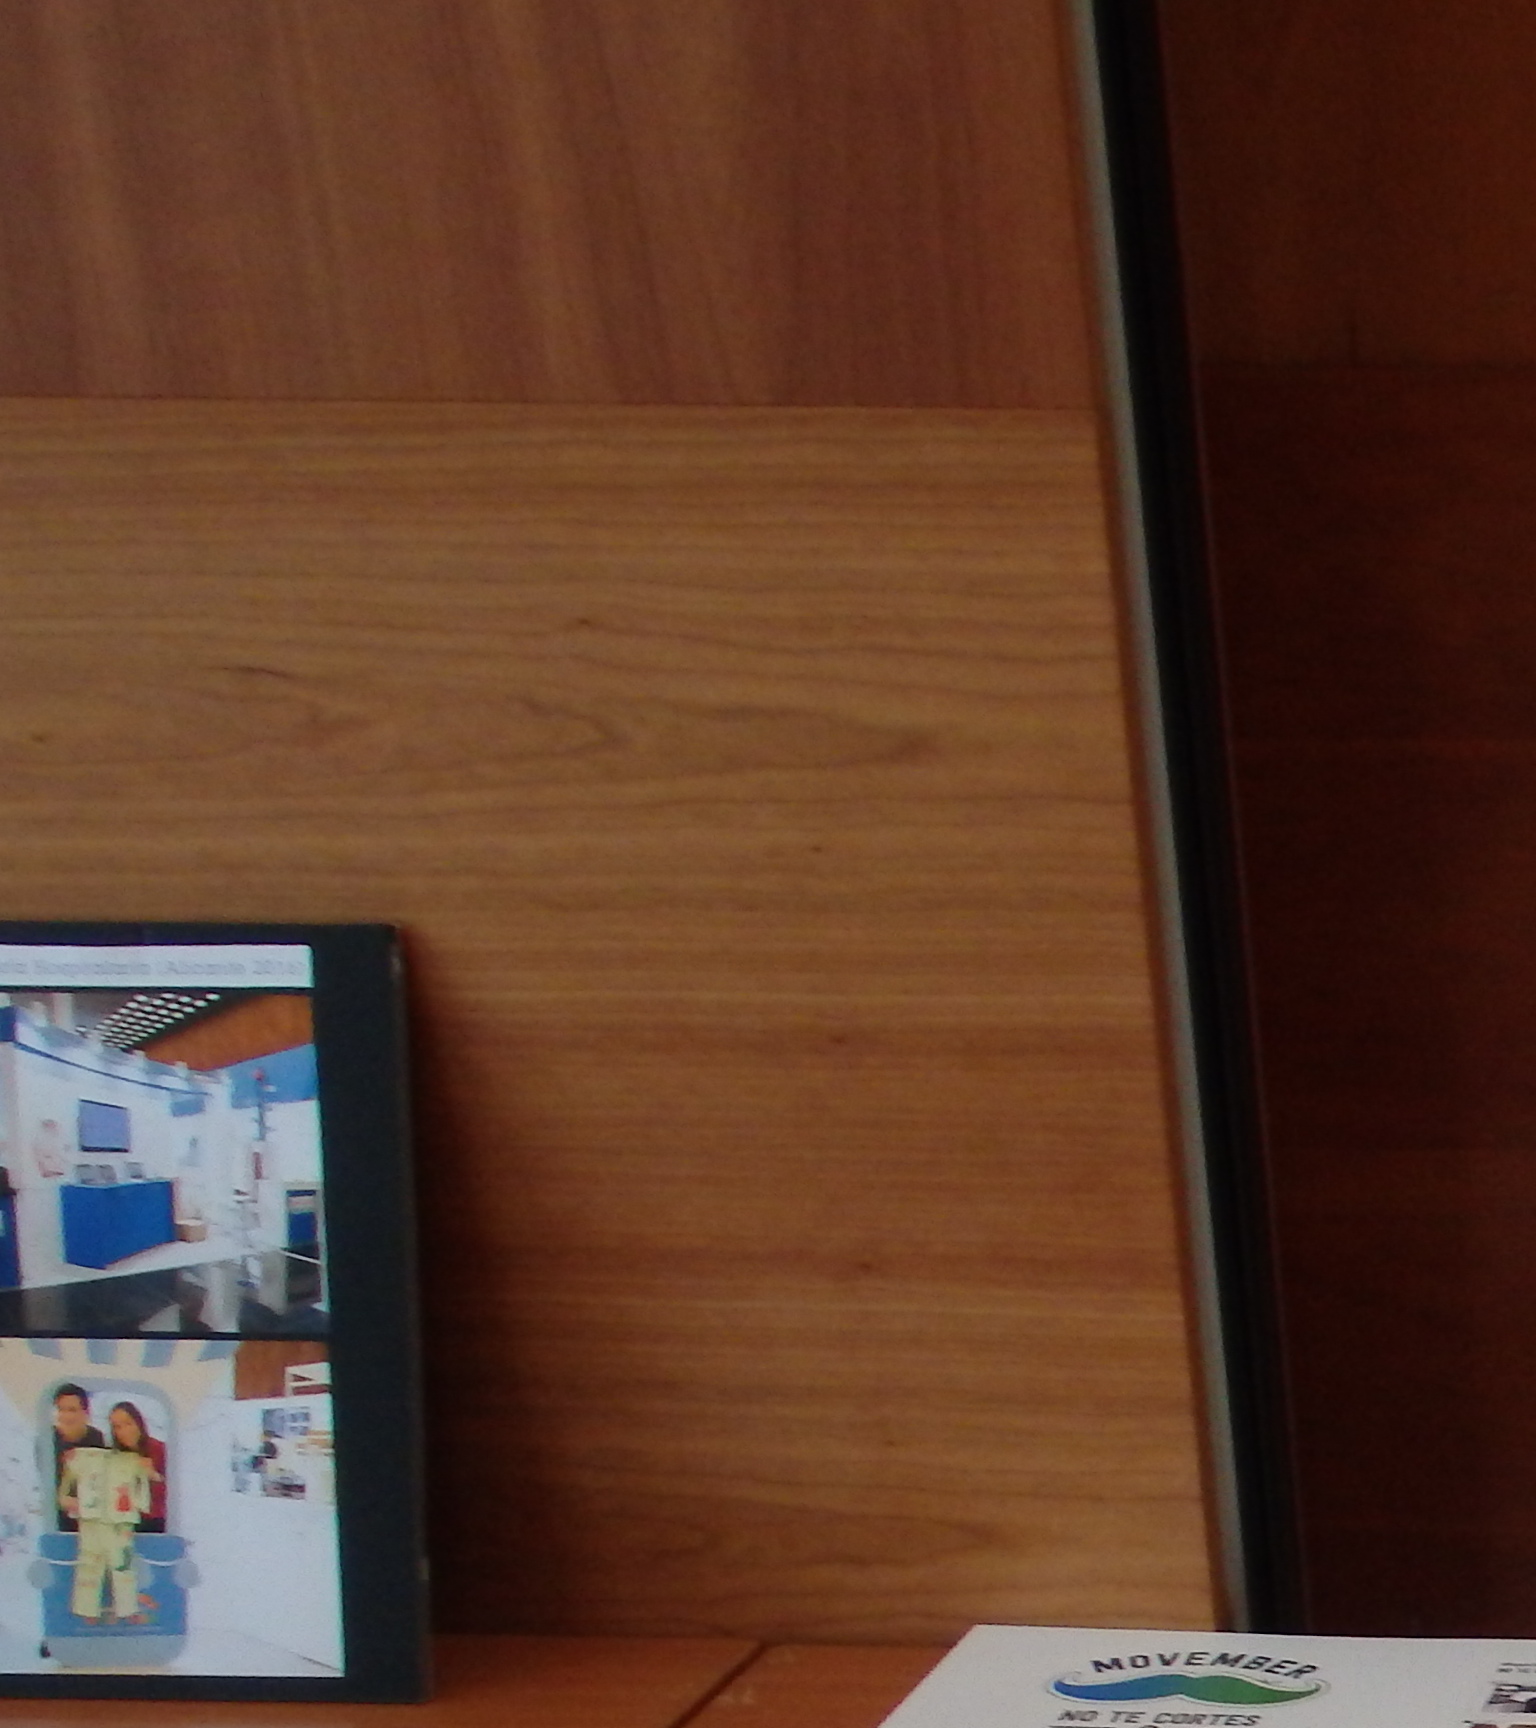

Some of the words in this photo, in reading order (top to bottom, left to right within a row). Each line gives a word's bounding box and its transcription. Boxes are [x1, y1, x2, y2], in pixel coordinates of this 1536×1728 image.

[1090, 1651, 1321, 1679] MOVEMBER
[1057, 1710, 1100, 1724] NO
[1111, 1711, 1141, 1725] TE
[1153, 1712, 1261, 1727] CORTES
